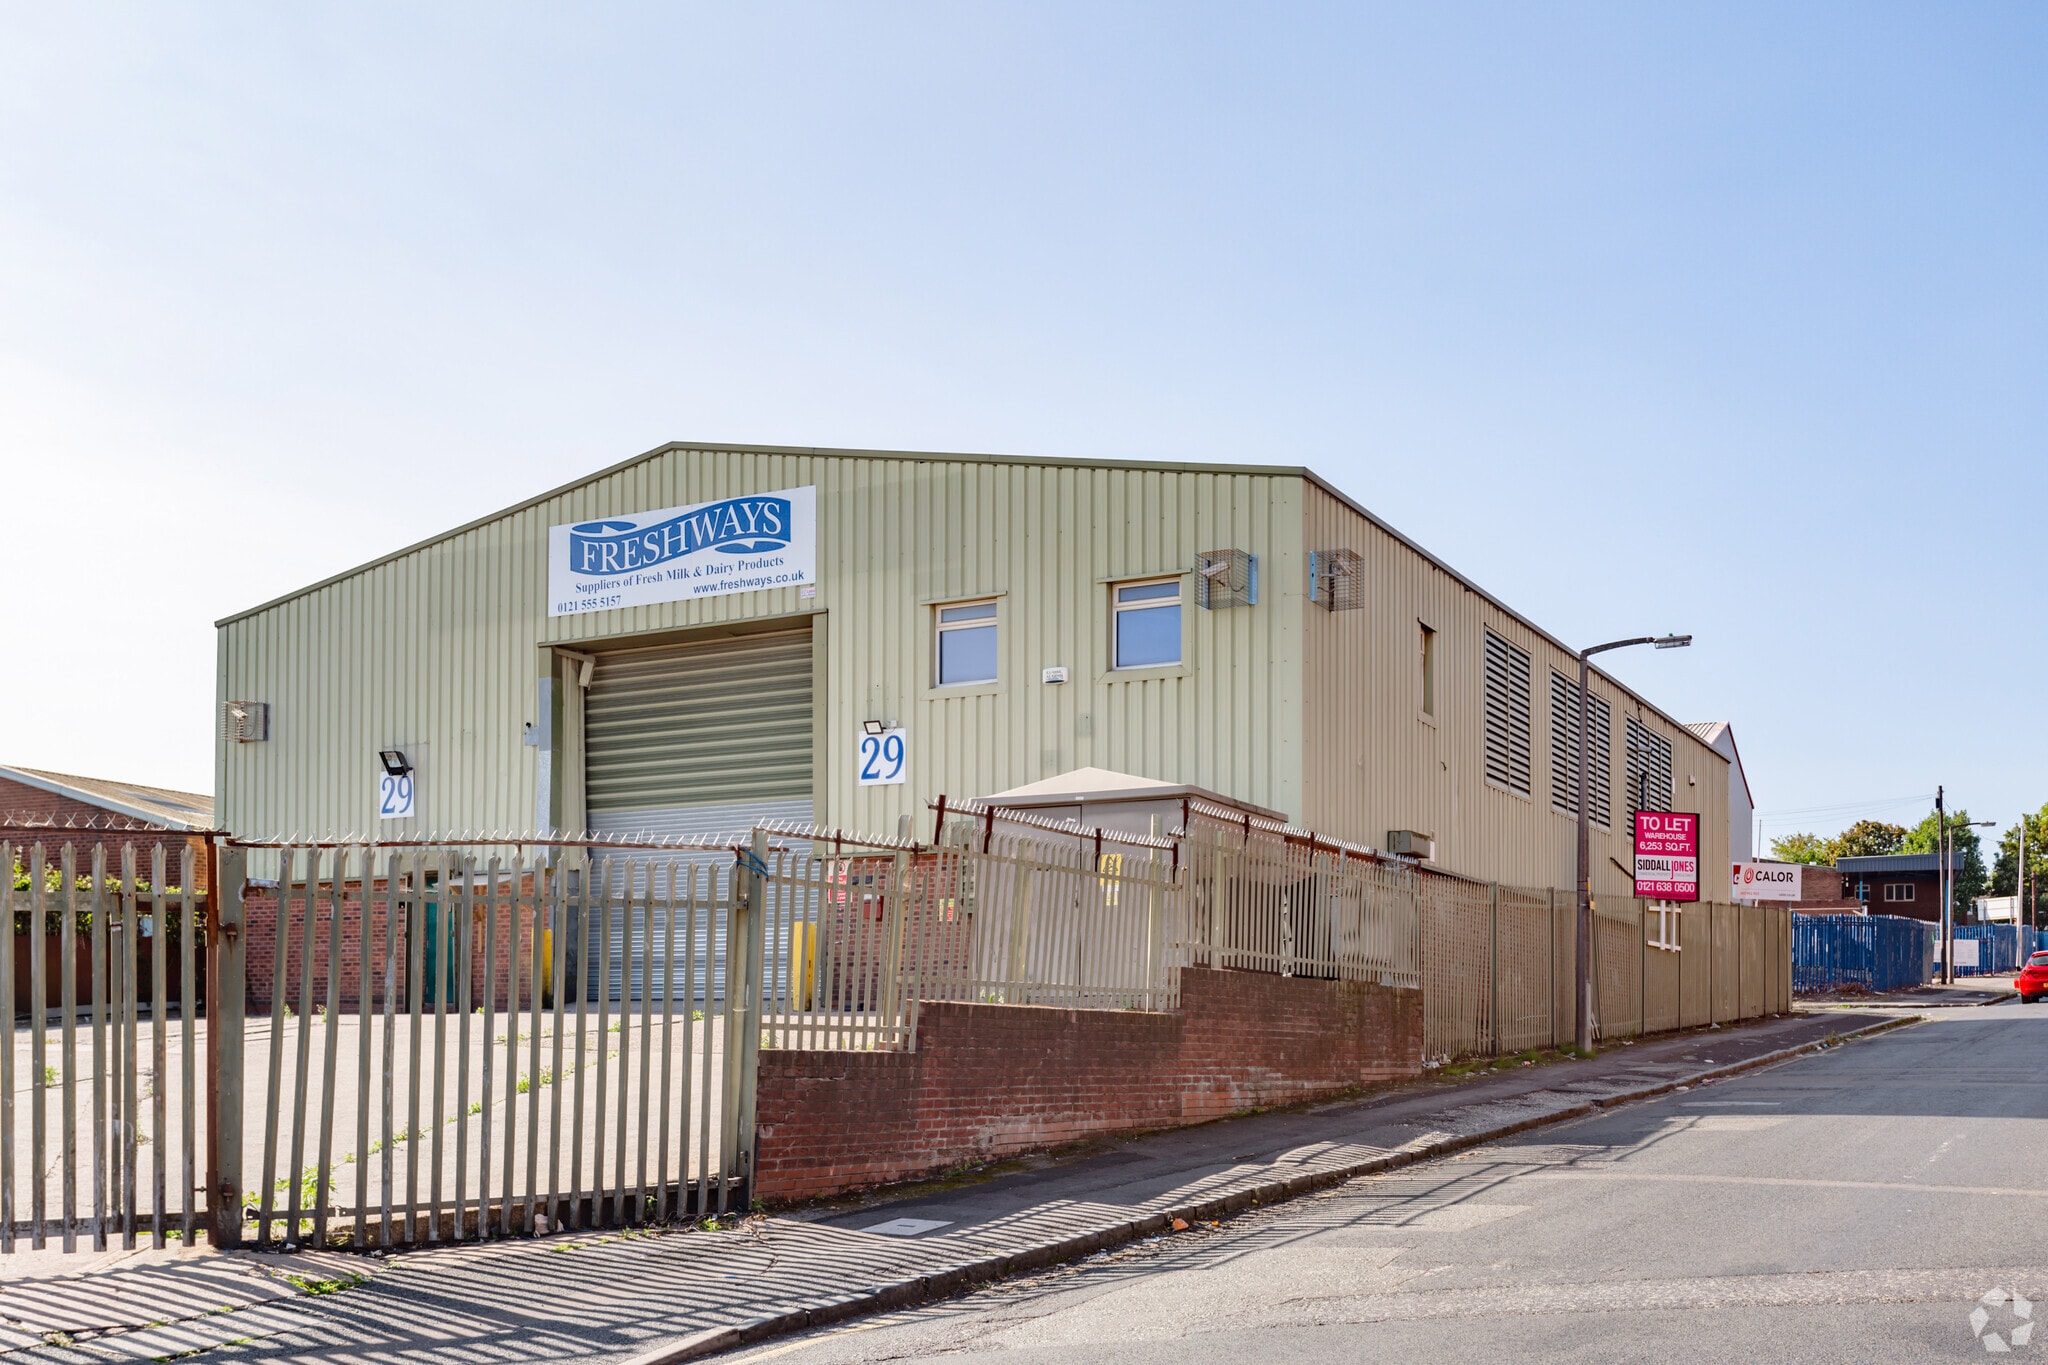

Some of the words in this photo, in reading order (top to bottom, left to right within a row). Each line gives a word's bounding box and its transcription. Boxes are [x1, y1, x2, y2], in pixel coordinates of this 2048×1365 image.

[580, 501, 782, 573] FRESHWAYS
[575, 578, 621, 595] Suppliers
[623, 575, 634, 587] of
[636, 571, 663, 585] Fresh
[667, 567, 690, 581] Milk
[693, 565, 702, 578] &
[706, 562, 735, 576] Dairy
[738, 556, 784, 572] Products
[693, 569, 805, 594] www.freshways.co.uk
[557, 601, 578, 613] 0121
[581, 598, 597, 611] 555
[600, 595, 621, 608] 5157
[861, 734, 904, 780] 29
[381, 774, 413, 814] 29
[1640, 816, 1660, 831] TO
[1664, 817, 1692, 832] LET
[1644, 832, 1687, 841] WAREHOUSE
[1639, 841, 1663, 851] 6,253
[1637, 859, 1671, 872] SIDDALL
[1755, 870, 1794, 883] CALOR
[1636, 881, 1655, 892] 0121
[1656, 882, 1672, 892] 638
[1674, 882, 1695, 893] 0500
